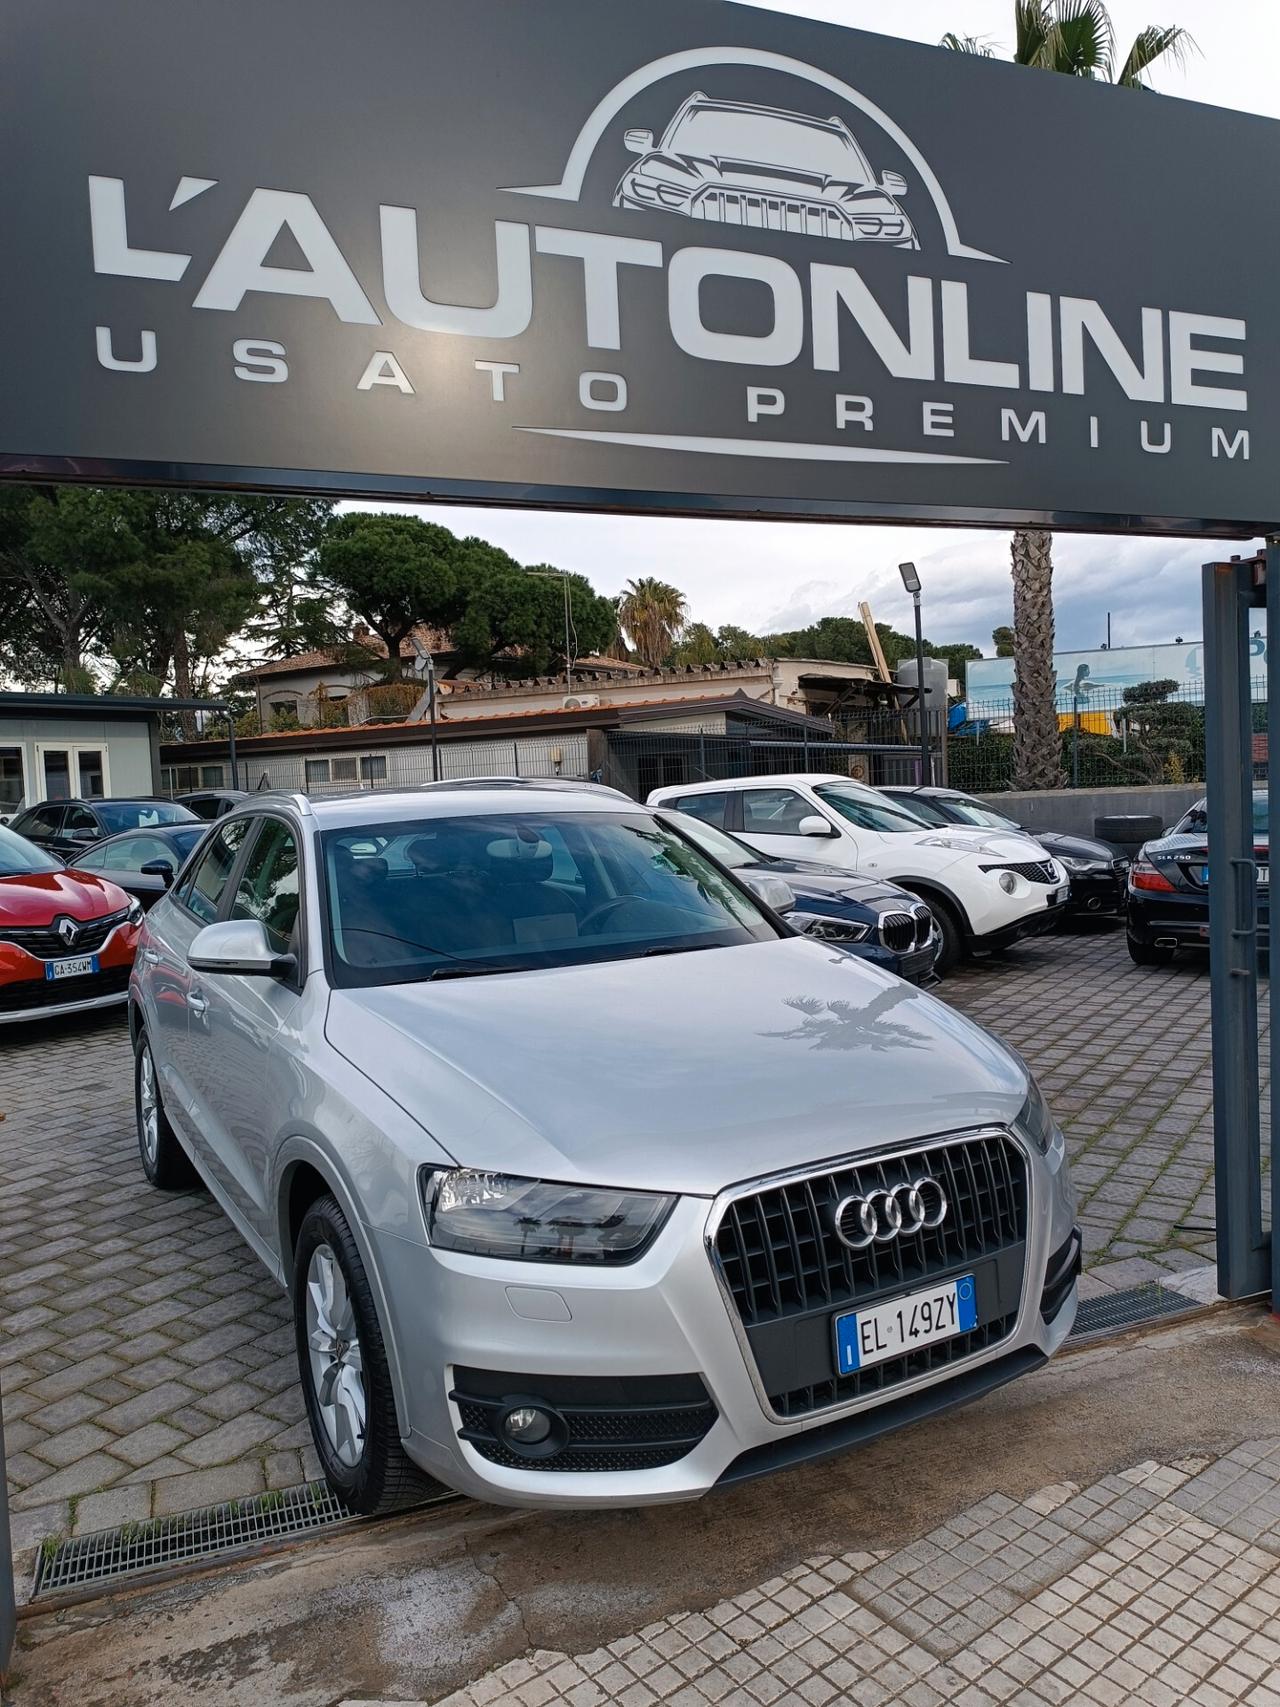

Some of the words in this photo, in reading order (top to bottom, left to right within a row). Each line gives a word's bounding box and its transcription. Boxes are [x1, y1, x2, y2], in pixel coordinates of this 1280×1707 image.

[88, 174, 1248, 412] L'AUTONLINE
[96, 326, 628, 412] USATO
[746, 386, 1250, 460] PREMIUM
[860, 1316, 887, 1355] EL
[896, 1292, 956, 1343] 149ZY
